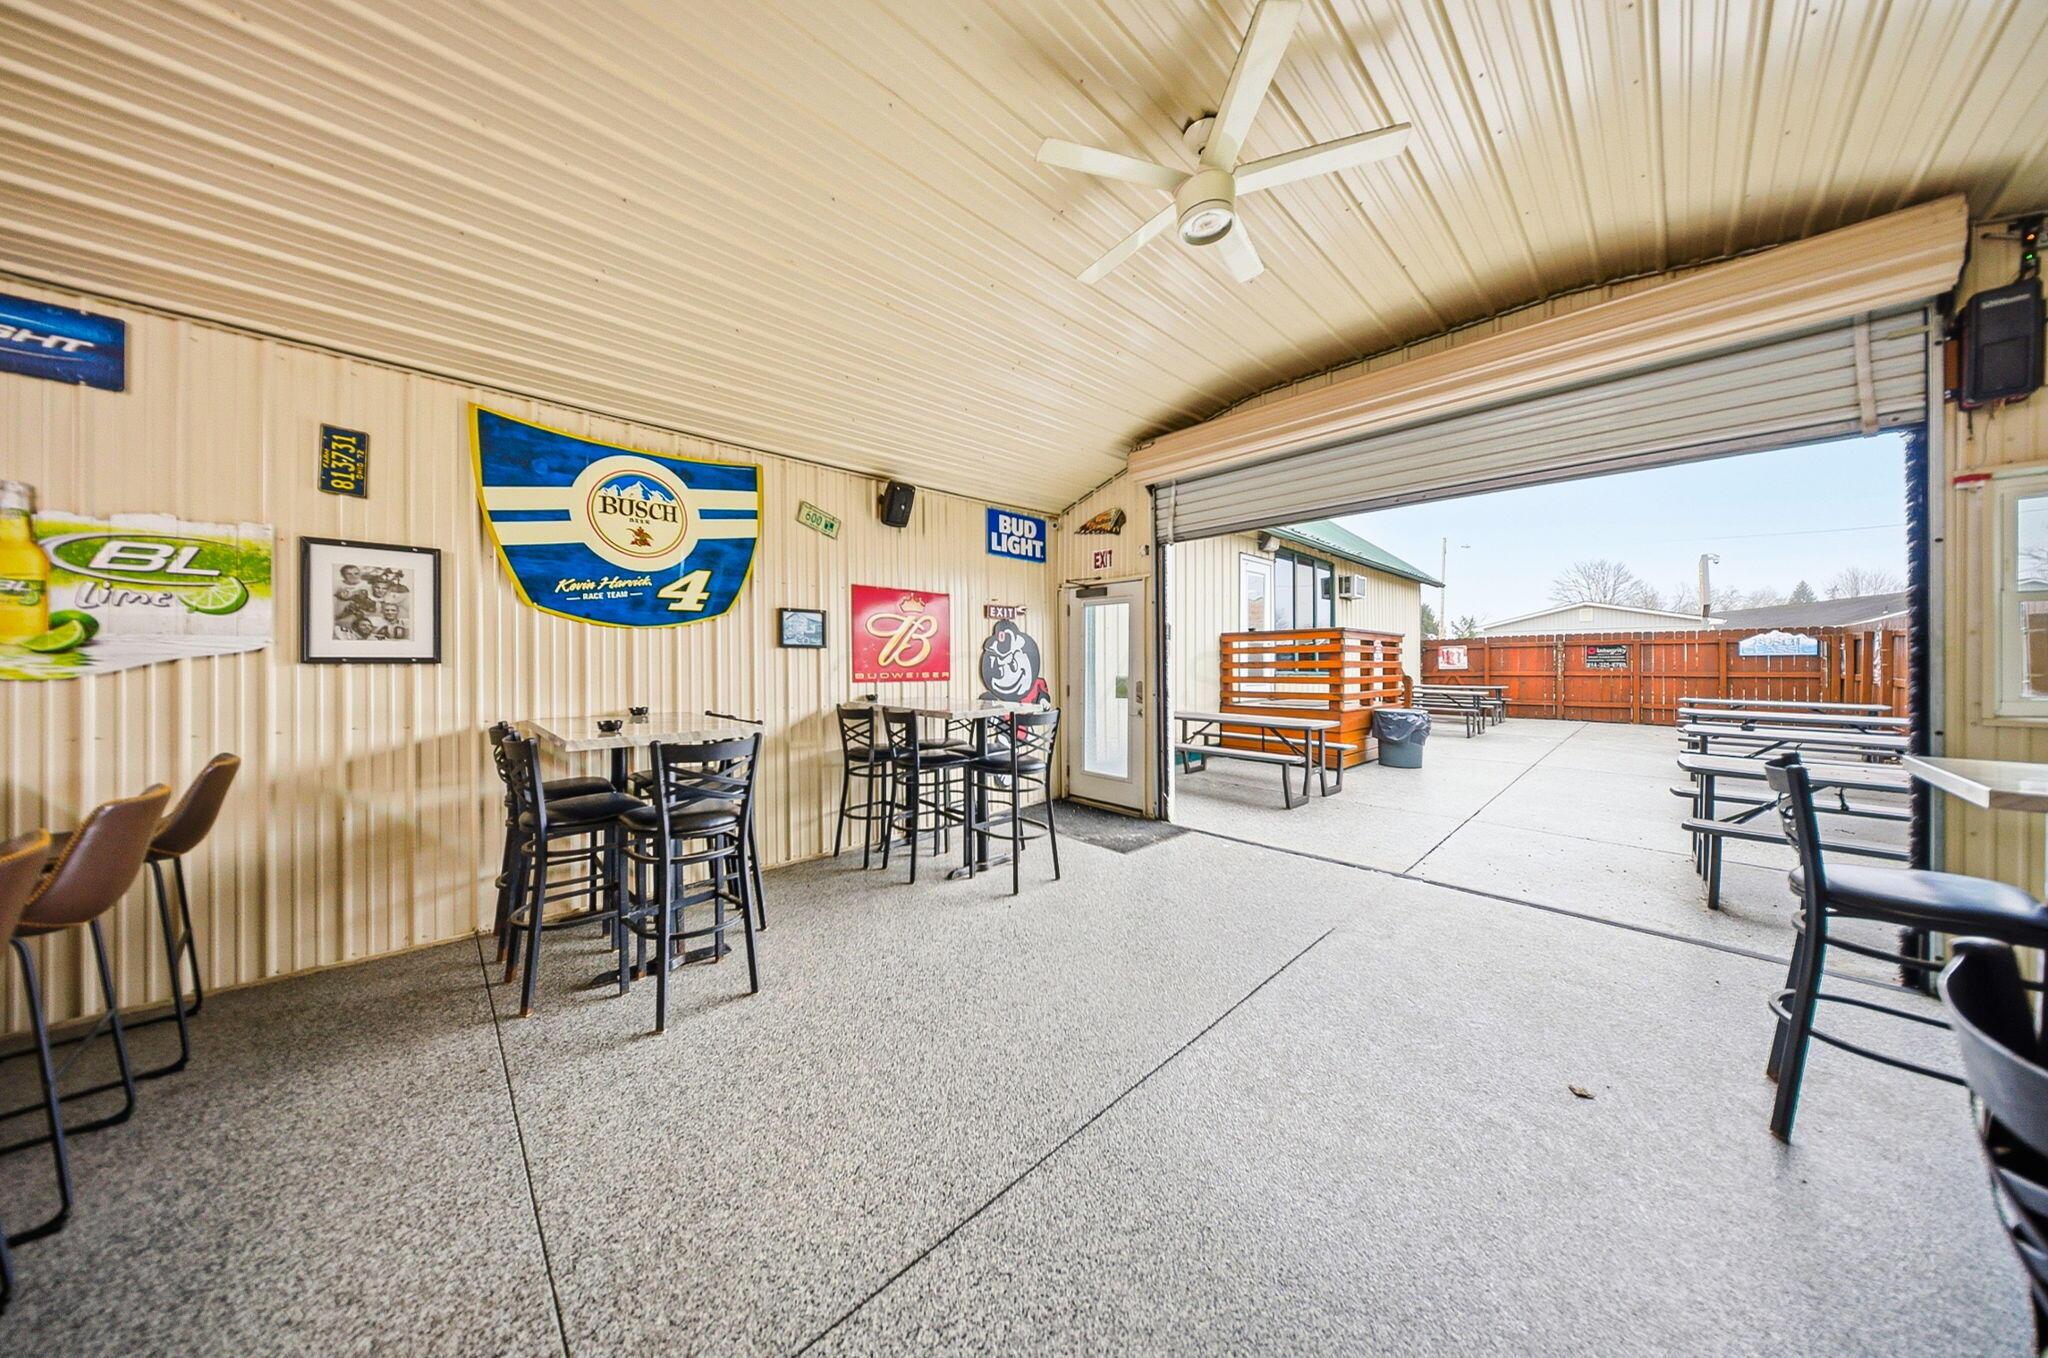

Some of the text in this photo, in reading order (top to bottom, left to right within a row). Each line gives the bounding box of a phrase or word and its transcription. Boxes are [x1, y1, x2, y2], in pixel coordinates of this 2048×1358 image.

[330, 435, 356, 489] 813731
[598, 495, 678, 523] BUSCH
[998, 514, 1038, 539] BUD
[991, 531, 1043, 559] LIGHT
[88, 540, 221, 577] BL
[1093, 550, 1113, 569] EXIT
[74, 580, 174, 609] Lime
[555, 575, 653, 593] Kevin Harvick
[582, 590, 629, 601] RACE TEAM
[656, 570, 712, 612] 4
[990, 606, 1013, 618] EXIT
[854, 671, 950, 679] BUDWEISER
